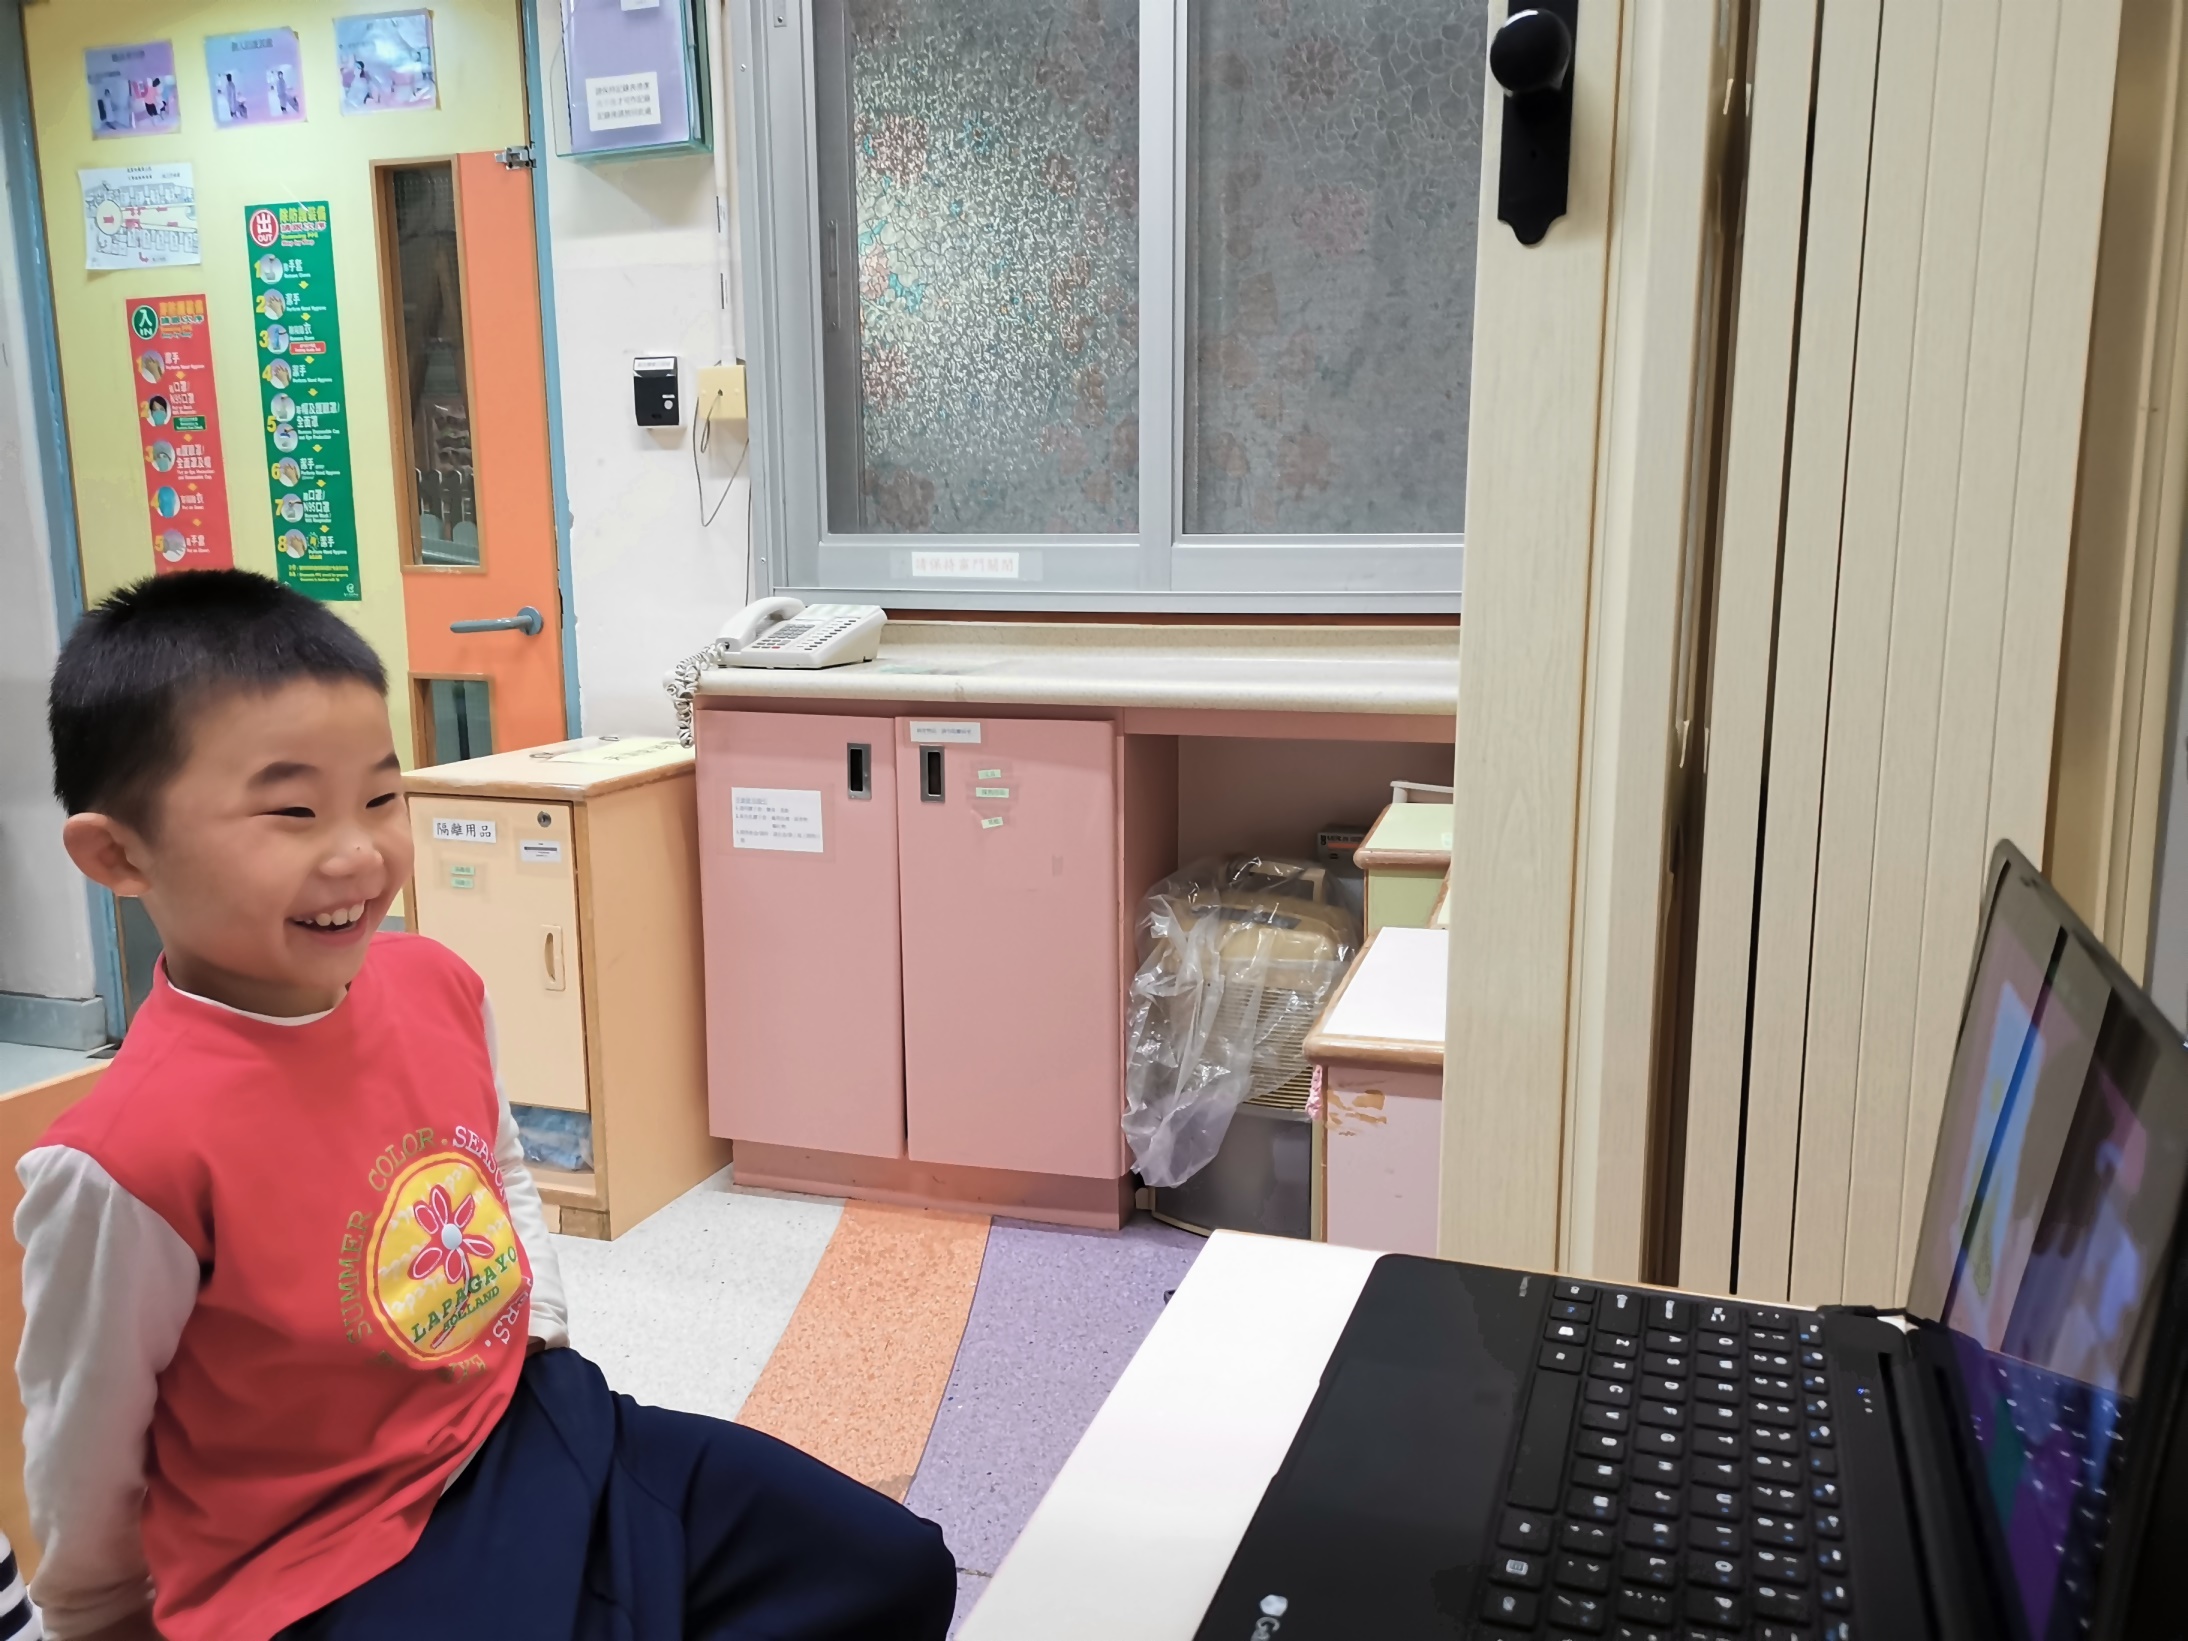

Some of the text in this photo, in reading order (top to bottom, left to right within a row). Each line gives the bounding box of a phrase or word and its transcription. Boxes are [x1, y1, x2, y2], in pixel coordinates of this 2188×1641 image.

[256, 212, 273, 234] 出
[257, 234, 273, 242] OUT
[139, 309, 153, 328] 入
[139, 327, 153, 336] IN
[267, 415, 277, 432] 5
[271, 463, 281, 480] 6
[274, 498, 284, 516] 7
[277, 535, 288, 552] 8
[436, 822, 492, 838] 隔離用品
[368, 1127, 436, 1192] COLOR
[338, 1210, 372, 1344] SUMMER
[411, 1245, 518, 1344] LAPAGAYO
[442, 1285, 500, 1333] HOLLAND
